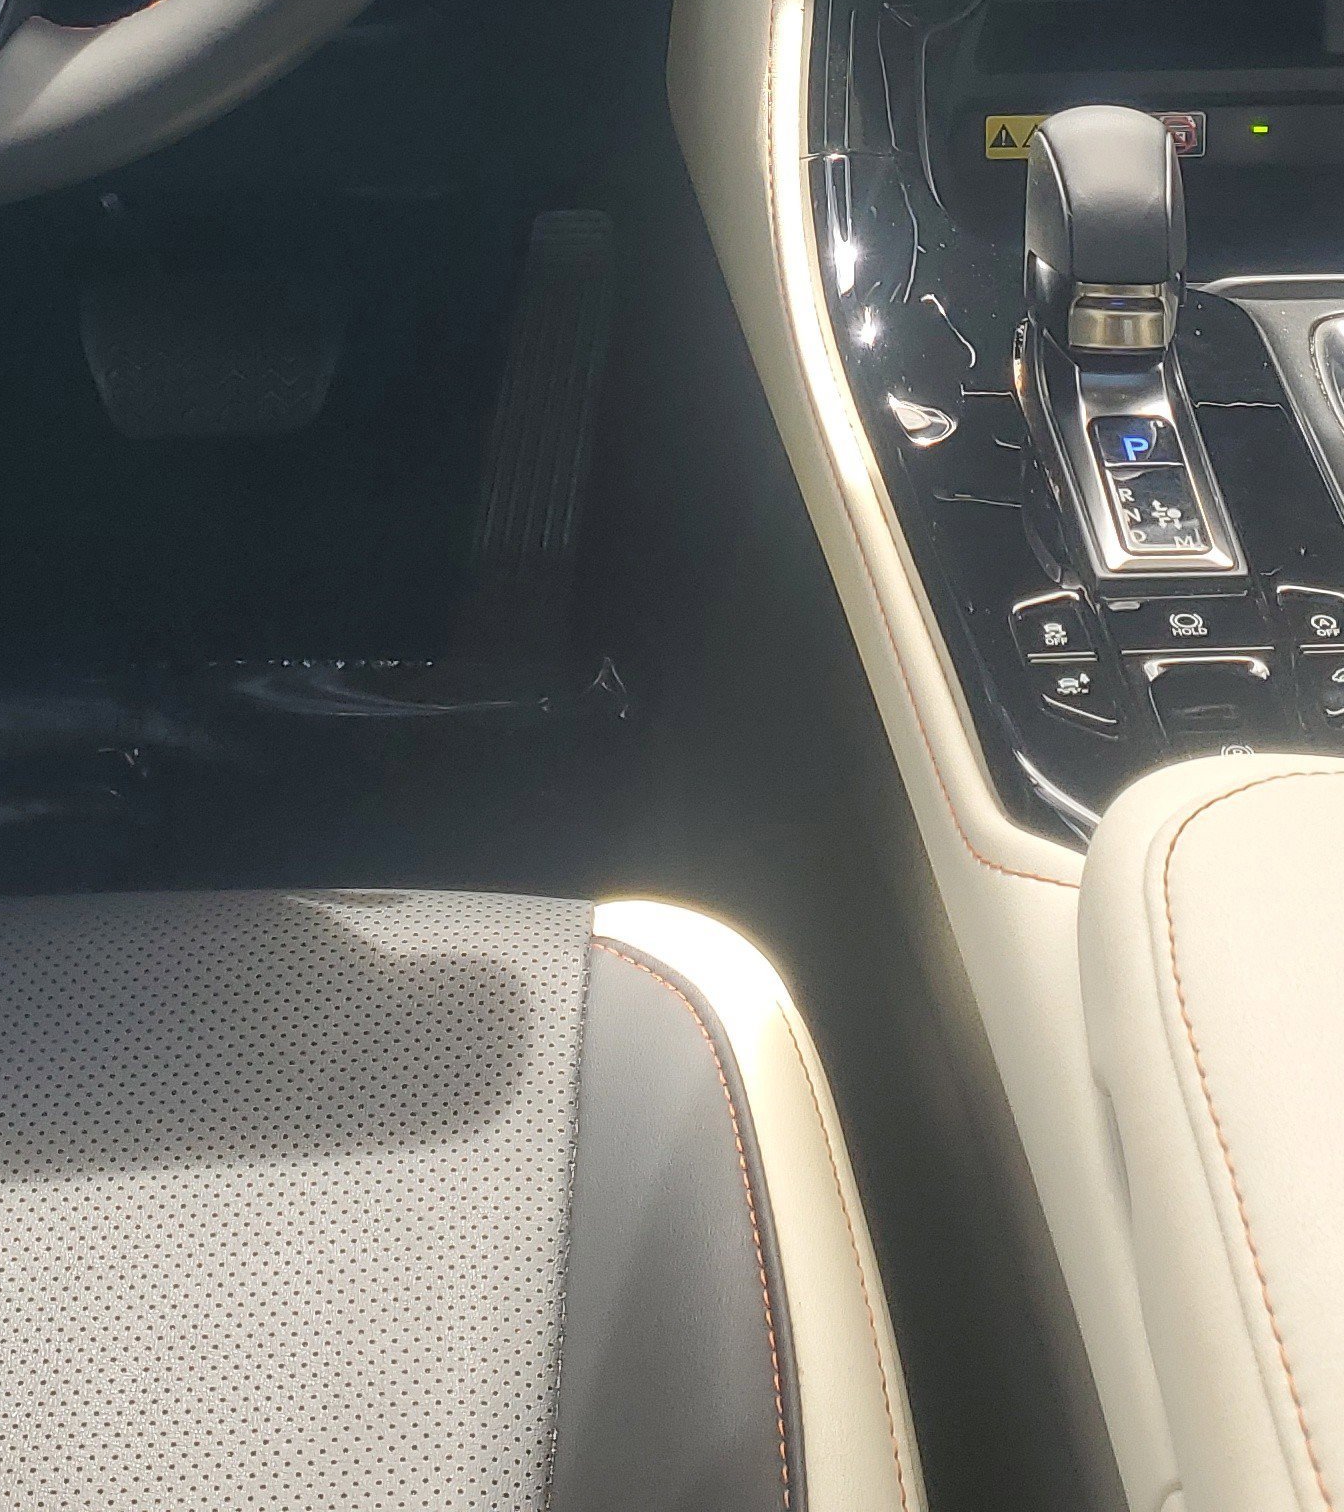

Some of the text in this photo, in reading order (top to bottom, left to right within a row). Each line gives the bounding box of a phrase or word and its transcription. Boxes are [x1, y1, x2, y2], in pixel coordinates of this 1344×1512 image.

[1122, 436, 1150, 461] P
[1118, 488, 1135, 503] R
[1124, 509, 1143, 522] N
[1174, 536, 1194, 548] M
[1171, 626, 1208, 637] HOLD
[1316, 627, 1340, 637] OFF
[1044, 635, 1068, 646] OFF
